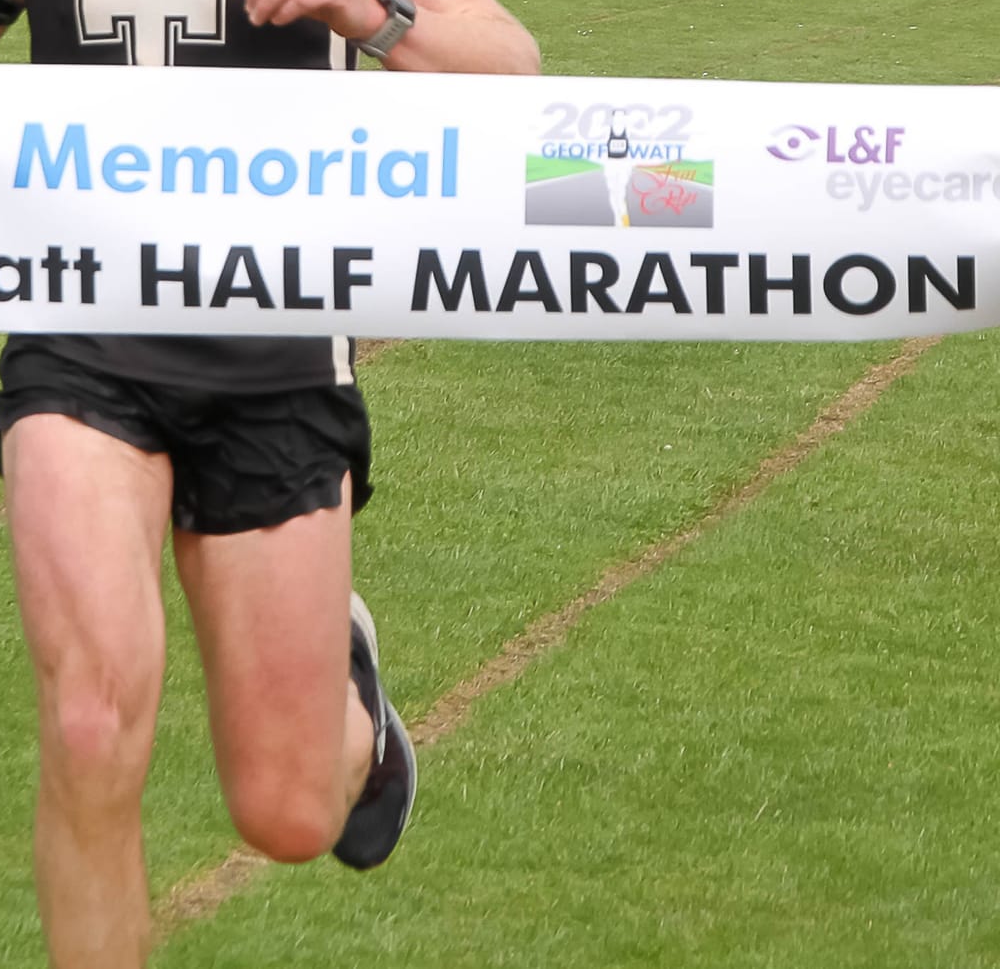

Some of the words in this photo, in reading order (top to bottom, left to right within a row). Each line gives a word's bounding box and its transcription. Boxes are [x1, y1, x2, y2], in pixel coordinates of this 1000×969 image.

[13, 123, 459, 198] Memorial
[628, 144, 687, 163] WATT
[826, 125, 906, 164] L&F
[825, 168, 1000, 212] eyecar
[140, 244, 374, 310] HALF
[410, 248, 976, 316] MARATHON
